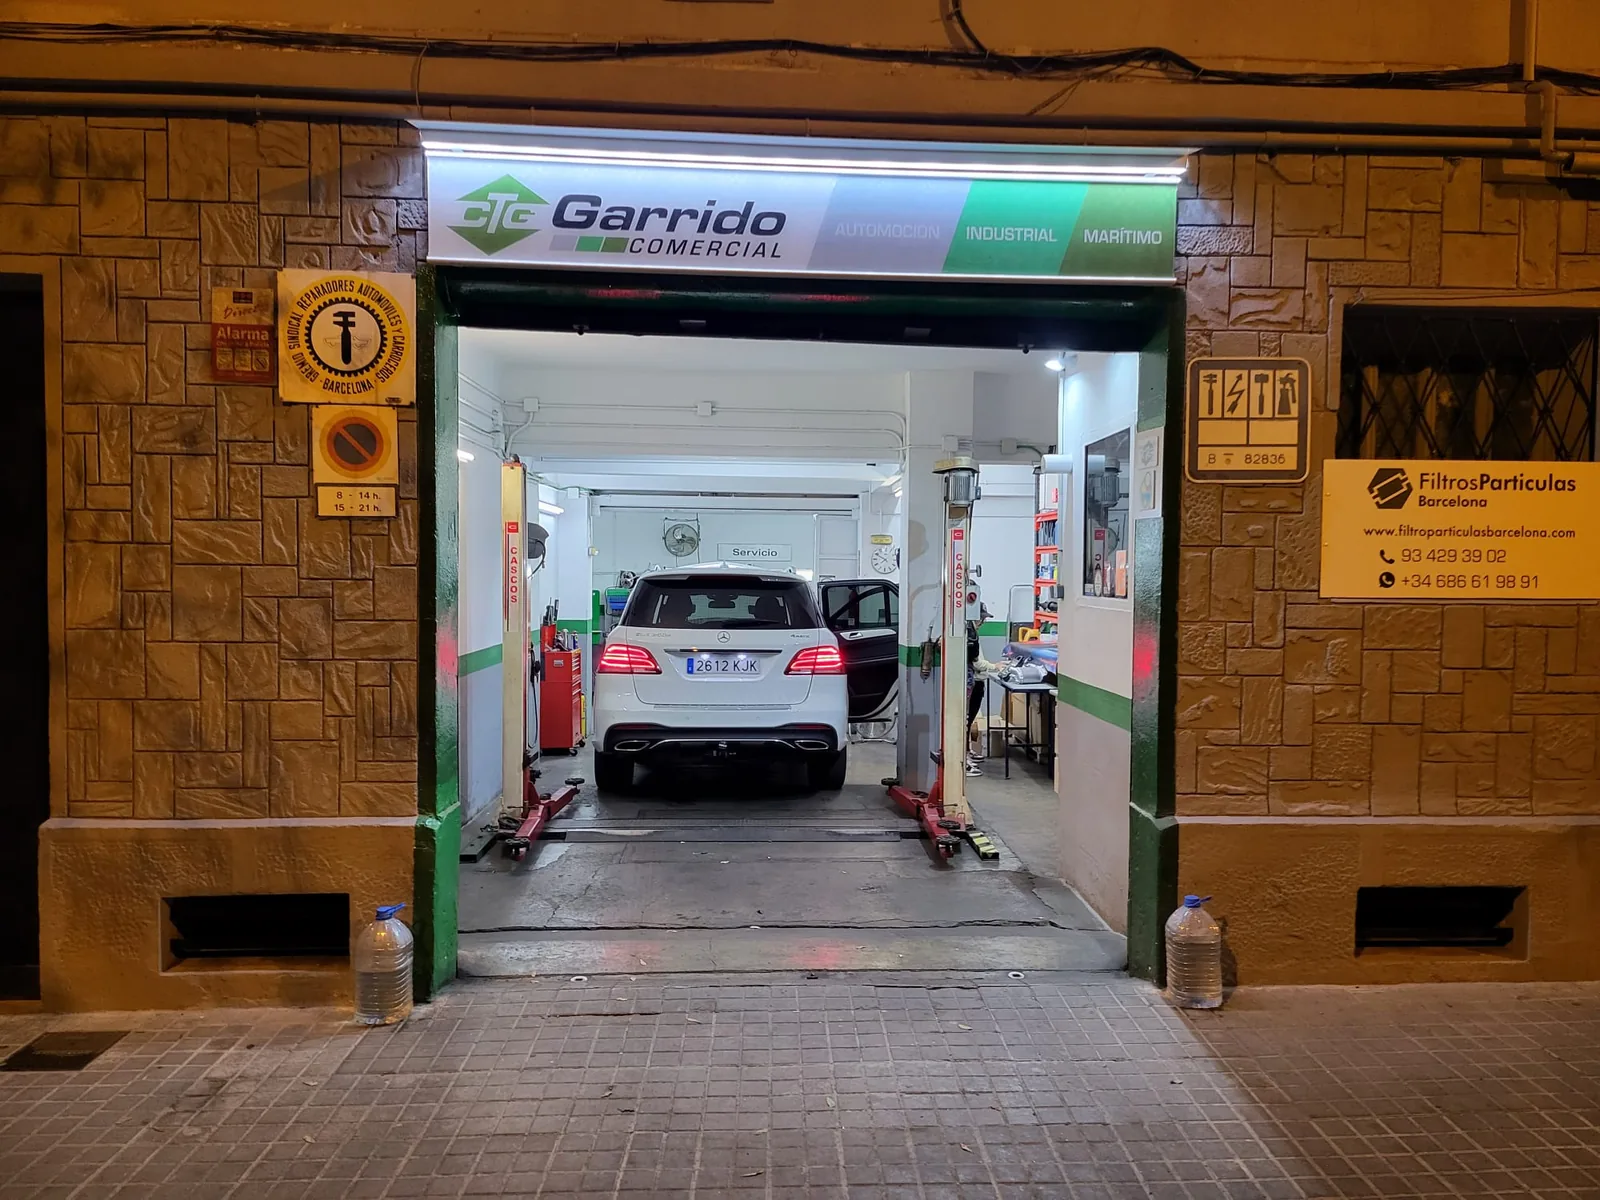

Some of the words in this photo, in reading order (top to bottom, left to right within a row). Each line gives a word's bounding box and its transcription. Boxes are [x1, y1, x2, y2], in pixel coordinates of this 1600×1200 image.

[456, 192, 548, 234] CTG
[552, 194, 787, 236] Garrido
[966, 226, 1057, 243] INDUSTRIAL
[1083, 227, 1163, 245] MARÍTIMO
[629, 238, 782, 259] COMERCIAL
[296, 279, 356, 311] REPARADORES
[357, 283, 403, 327] AUTOMOVILES
[216, 326, 270, 340] Alarma
[287, 311, 304, 350] SINDICAL
[292, 352, 320, 383] GREMIO
[375, 335, 405, 383] CARROCEROS
[322, 378, 375, 395] BARCELONA
[336, 491, 343, 499] 8
[359, 491, 370, 499] 14
[1418, 495, 1488, 508] Barcelona
[732, 547, 778, 558] Servicio
[1401, 548, 1422, 563] 93
[1426, 549, 1458, 563] 429
[1462, 549, 1483, 563] 39
[1486, 549, 1507, 563] 02
[510, 546, 518, 603] CASCOS
[955, 553, 963, 608] CASCOS
[1401, 574, 1432, 588] +34
[1436, 574, 1467, 588] 686
[1471, 575, 1490, 588] 61
[1495, 575, 1516, 588] 98
[1520, 575, 1539, 589] 91
[696, 660, 729, 672] 2612
[733, 660, 757, 672] KJK
